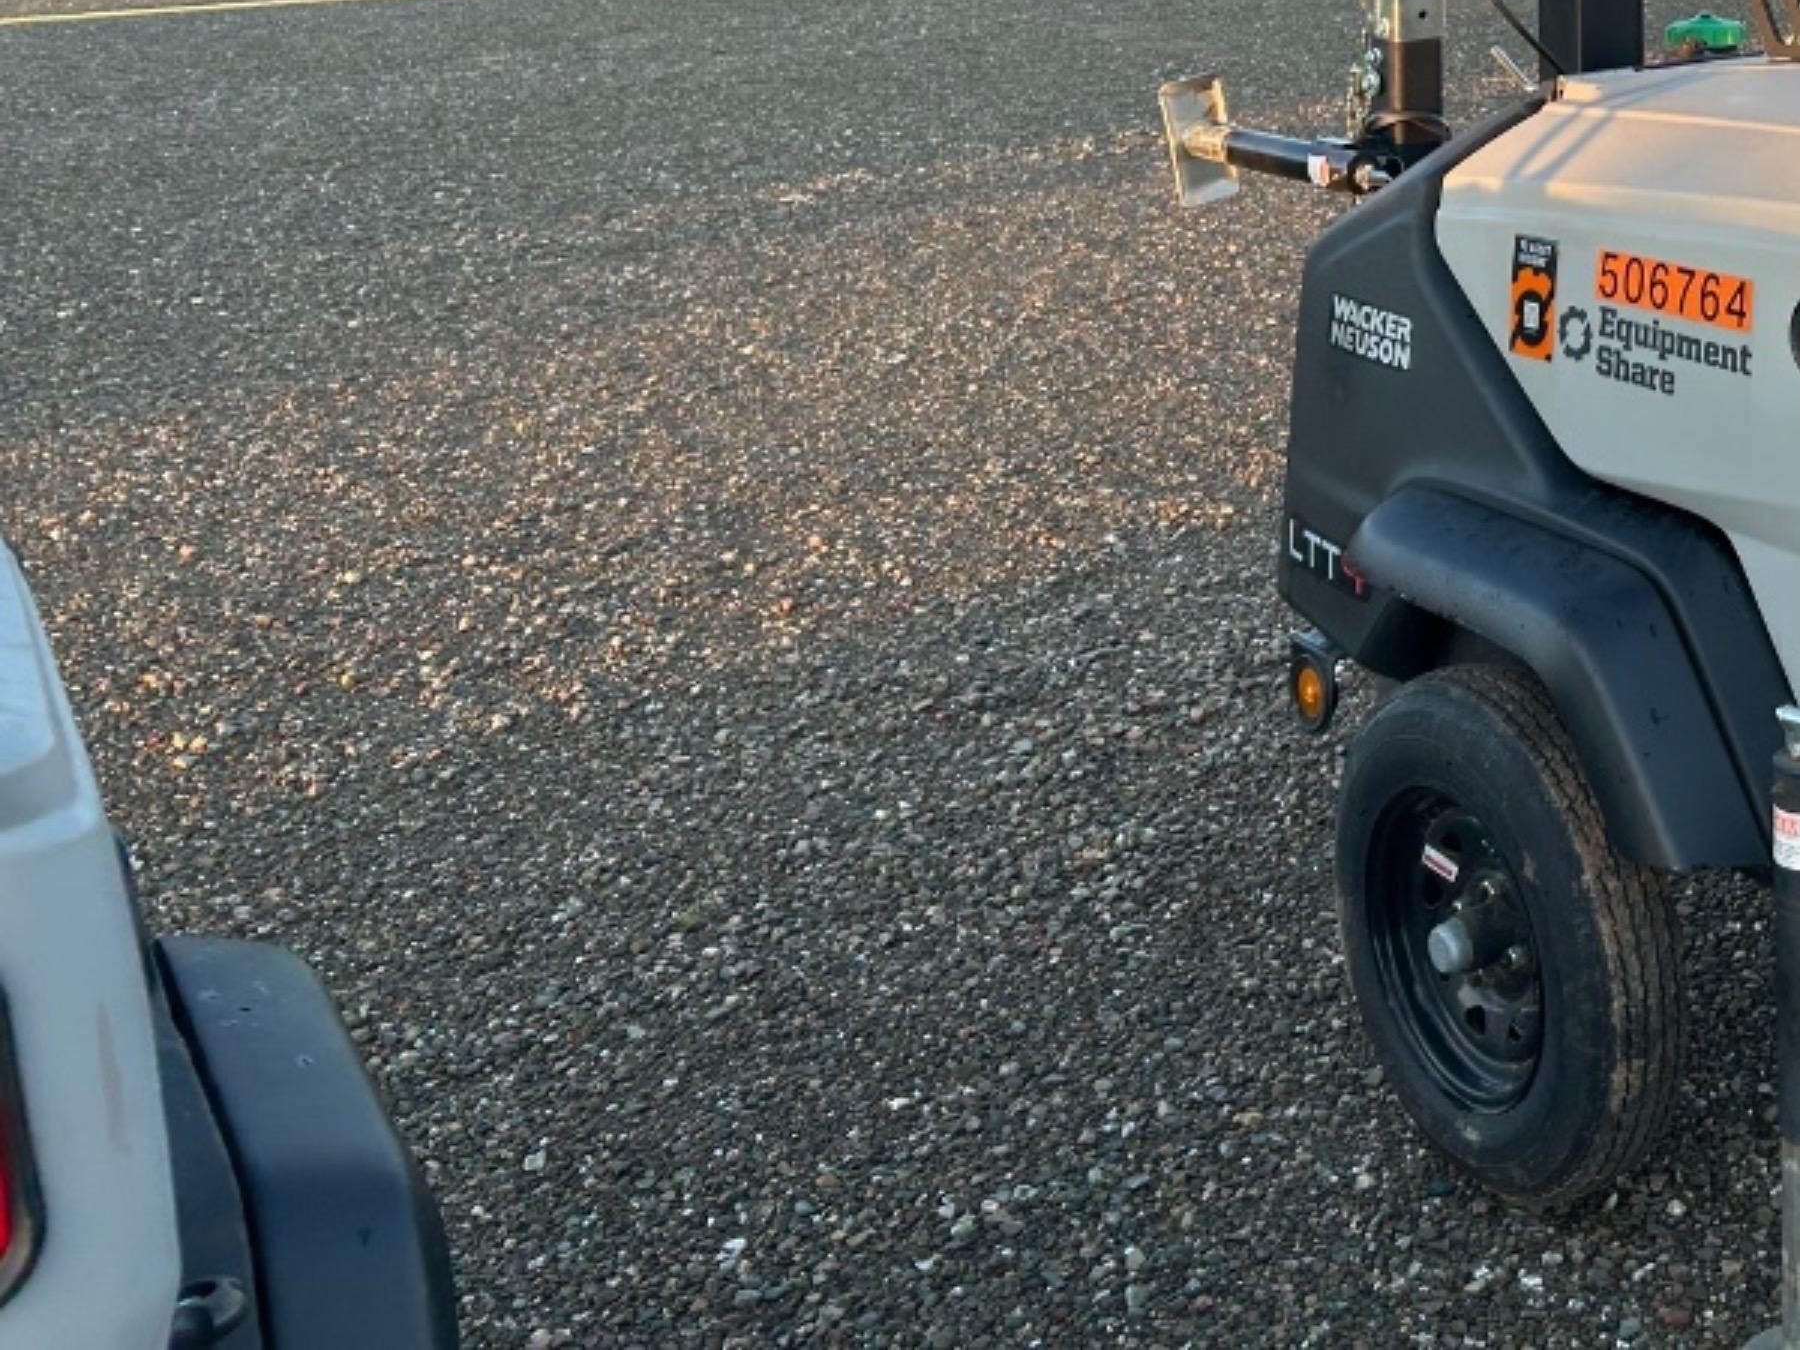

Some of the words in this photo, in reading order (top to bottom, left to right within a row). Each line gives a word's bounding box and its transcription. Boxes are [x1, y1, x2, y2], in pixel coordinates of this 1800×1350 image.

[1599, 251, 1748, 329] 506764
[1333, 293, 1412, 344] WACKER
[1599, 306, 1753, 377] Equipment
[1331, 320, 1411, 371] NEUSON
[1596, 344, 1676, 396] Share
